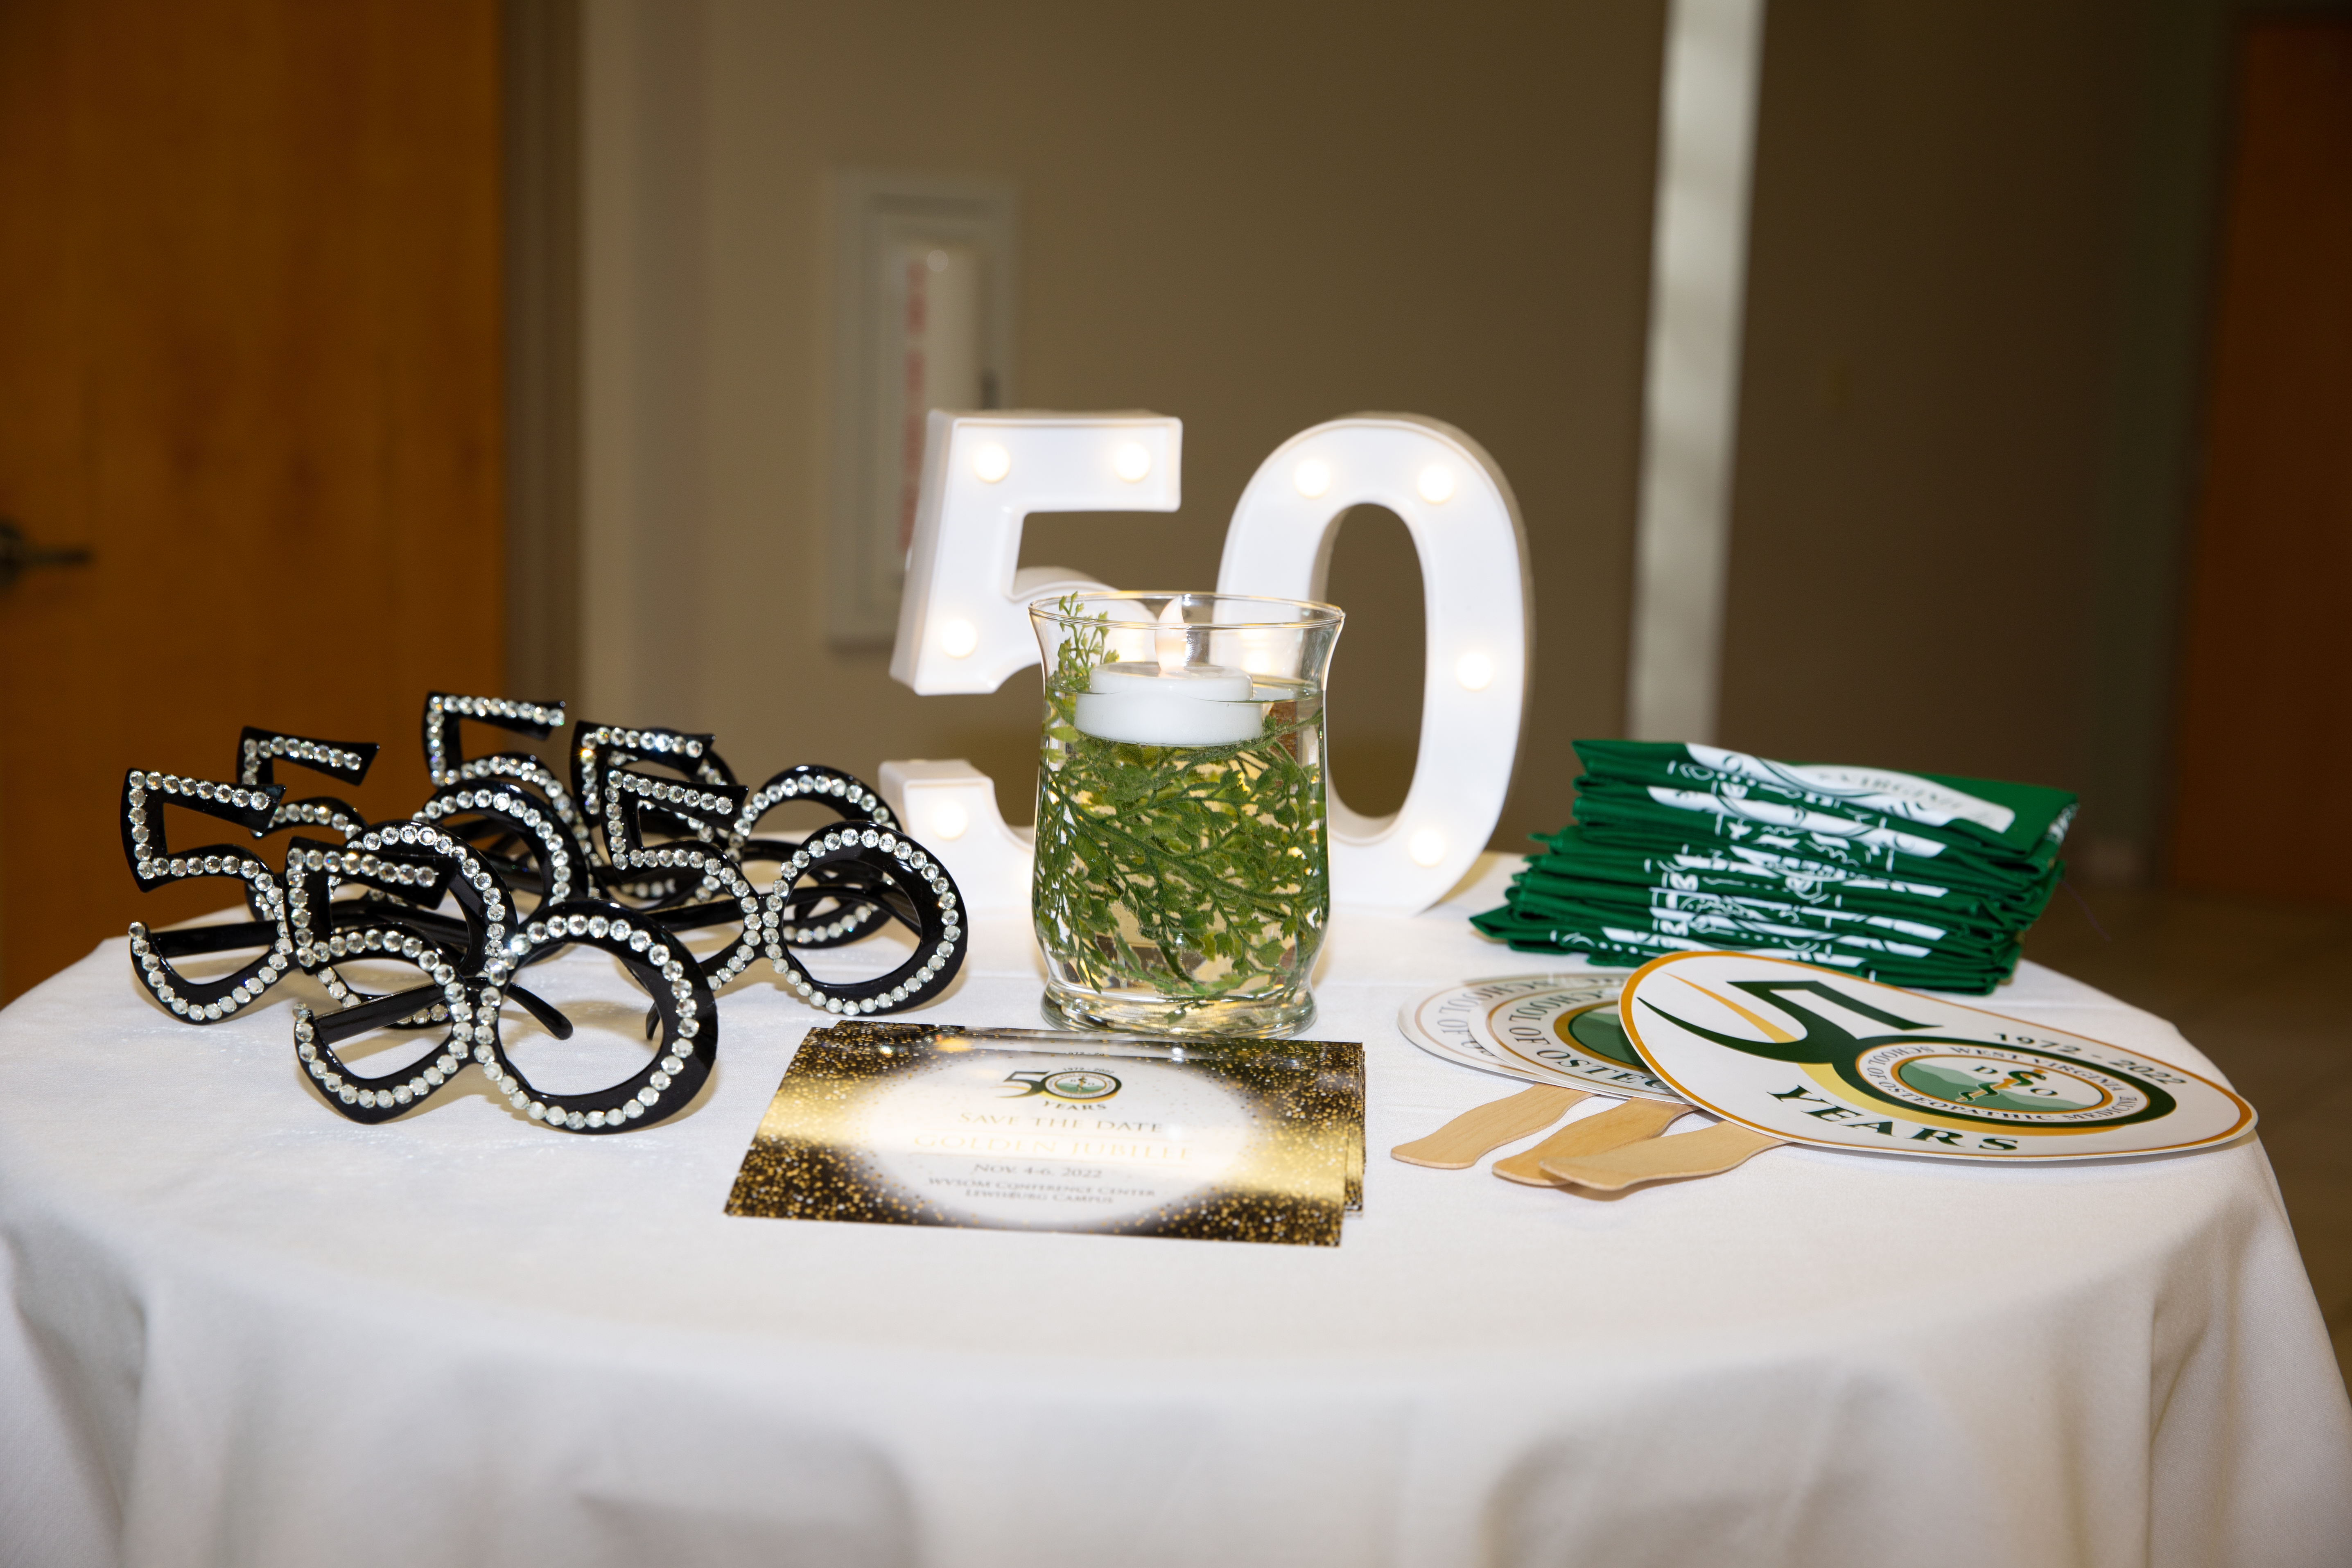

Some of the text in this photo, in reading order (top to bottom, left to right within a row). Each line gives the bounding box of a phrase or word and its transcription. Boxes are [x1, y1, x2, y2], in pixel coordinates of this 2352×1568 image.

[287, 837, 717, 1134] 50
[1509, 1027, 1551, 1045] OF
[1637, 981, 2177, 1127] 50
[1949, 1046, 2128, 1092] WEST VIRGINIA
[1995, 1033, 2081, 1053] 1972
[2108, 1059, 2187, 1084] 2022
[995, 1071, 1122, 1099] 50
[1867, 1046, 2138, 1121] SCHOOL OF OSTEOPATHIC MEDICINE
[959, 1112, 1164, 1133] SAVE THE DATE
[1043, 1100, 1107, 1111] YEARS
[1766, 1084, 2019, 1151] YEARS
[913, 1134, 1195, 1160] GOLDEN JUBILEE
[1061, 1167, 1103, 1179] 2022
